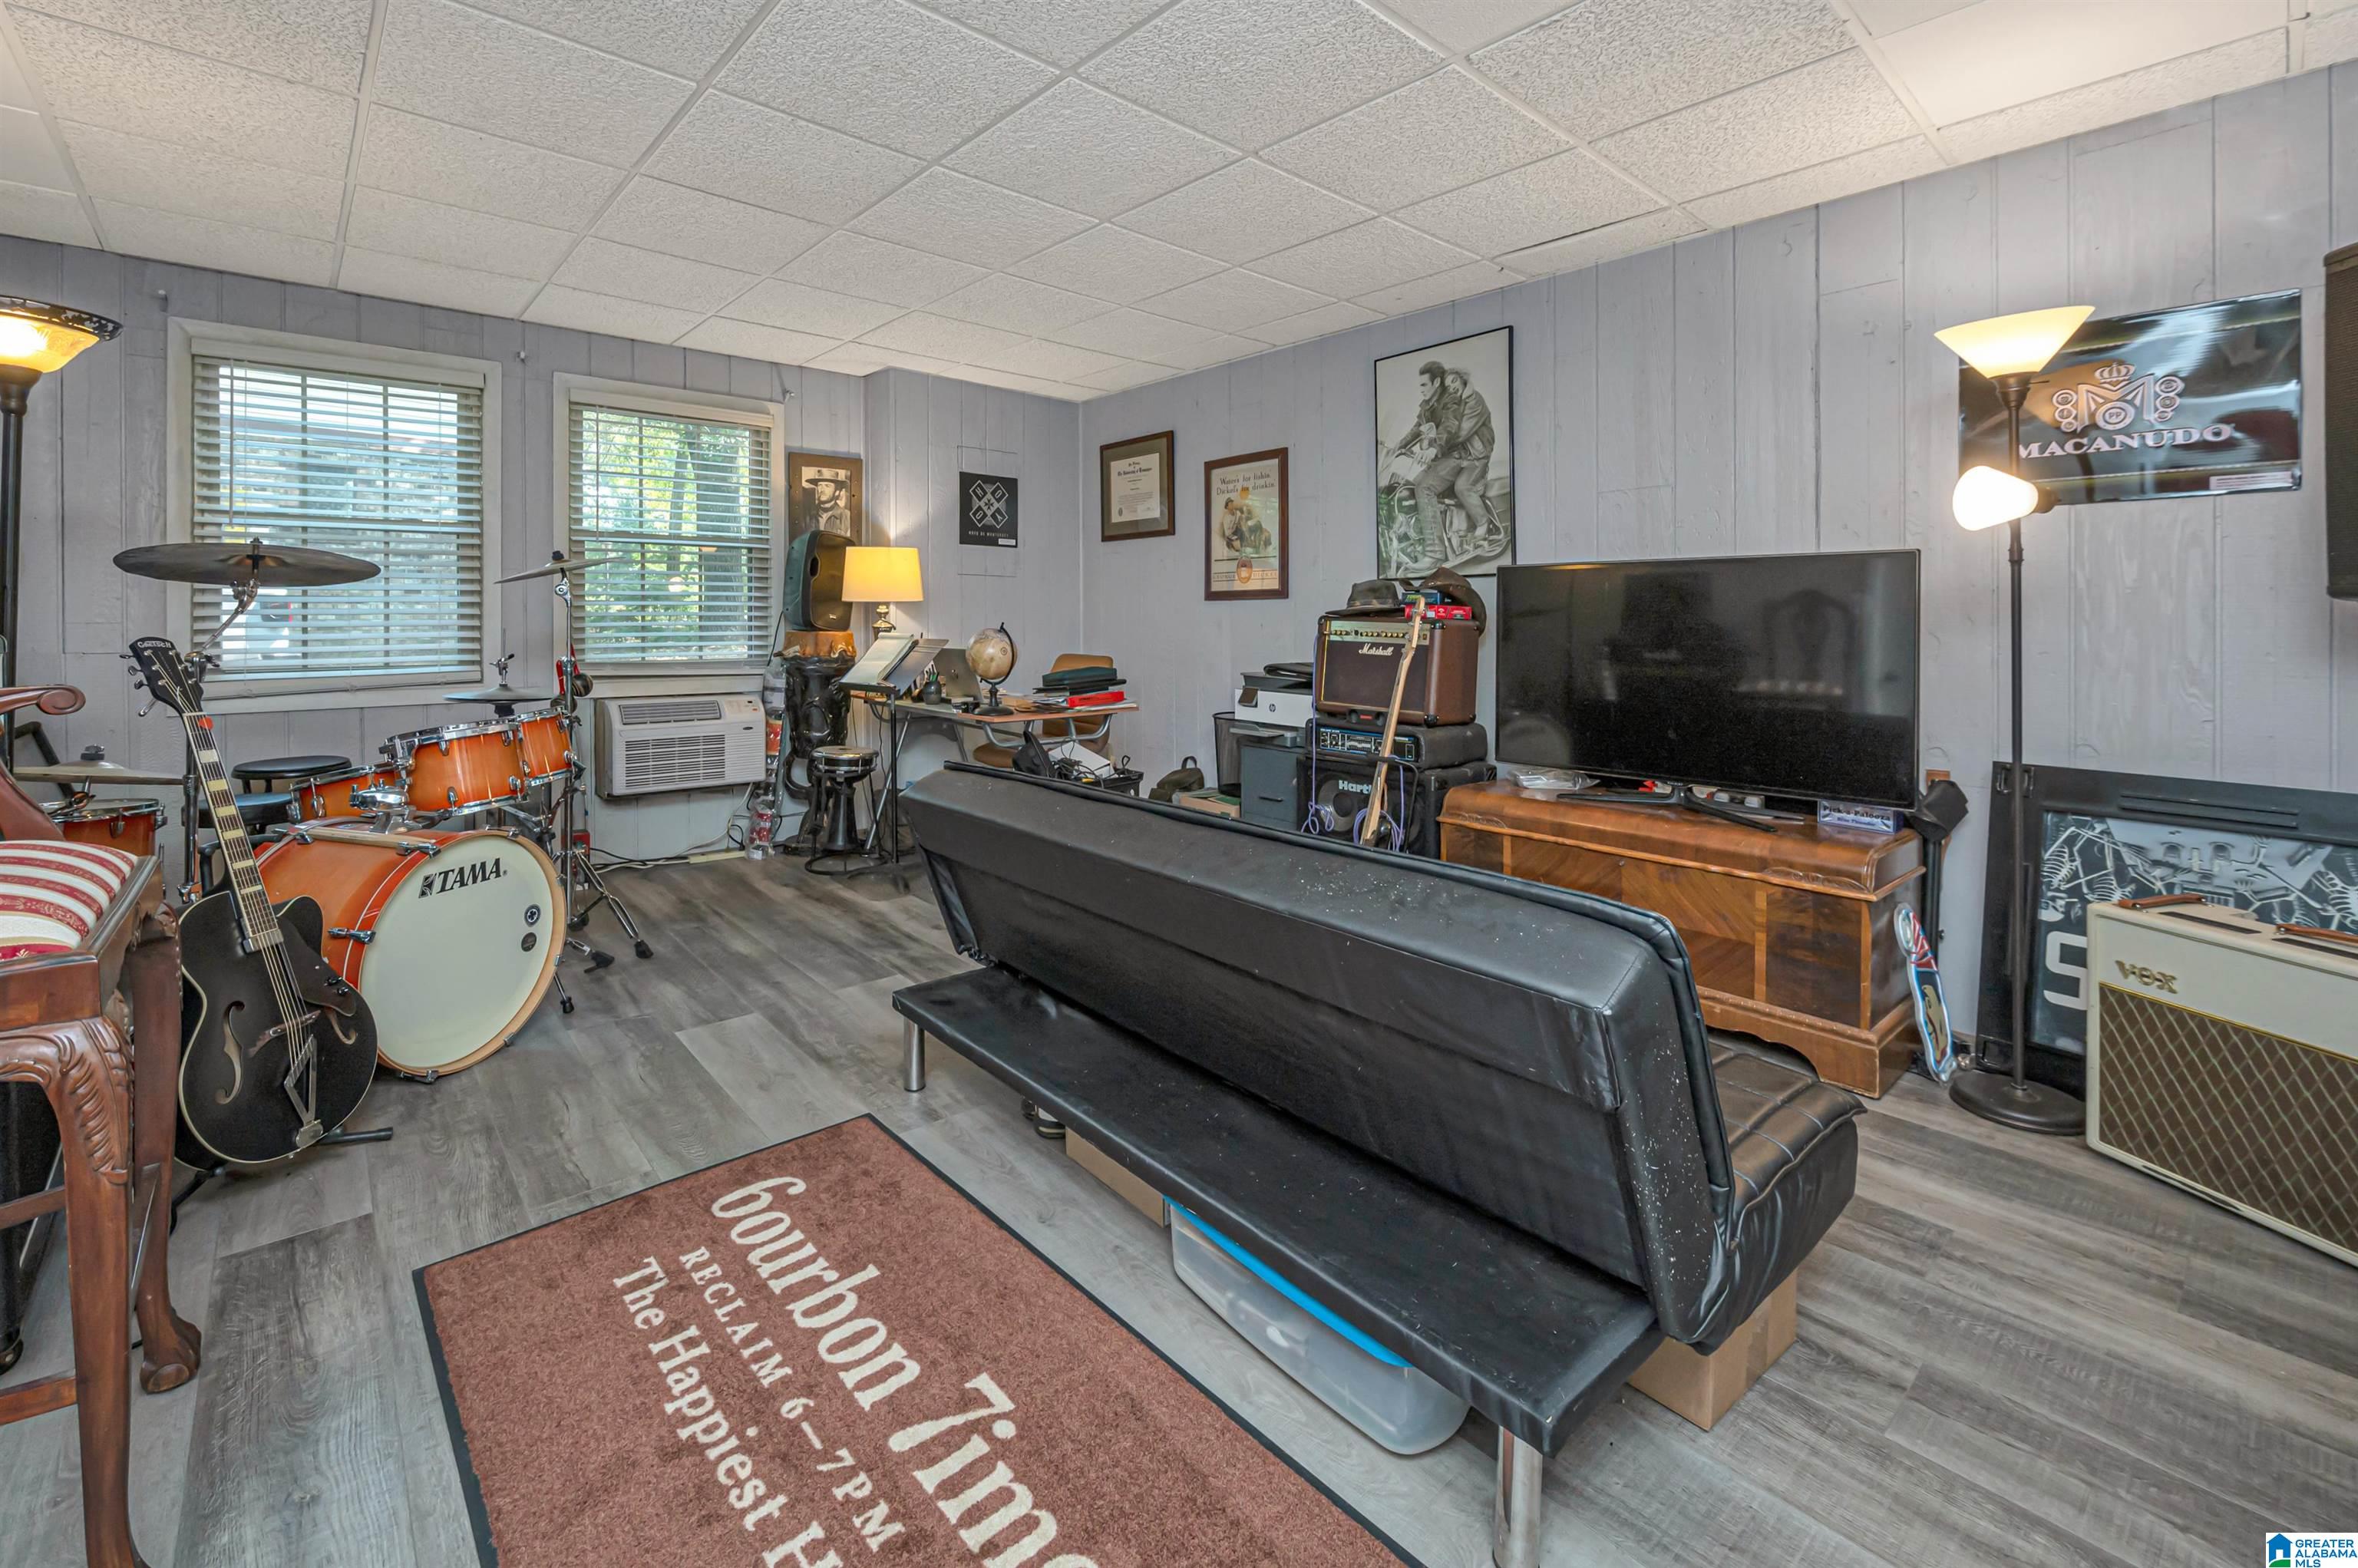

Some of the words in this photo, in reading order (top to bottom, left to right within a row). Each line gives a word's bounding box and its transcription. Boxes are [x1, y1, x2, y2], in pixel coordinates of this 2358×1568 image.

[2019, 423, 2232, 460] MACANUDO
[137, 640, 172, 649] GRETSCH
[1359, 642, 1394, 655] Marshall
[1339, 780, 1372, 794] Hart
[435, 857, 502, 894] TAMA
[2115, 959, 2178, 995] VOX
[679, 1246, 794, 1388] RECLAIM
[613, 1256, 669, 1330] The
[649, 1325, 788, 1532] Happiest
